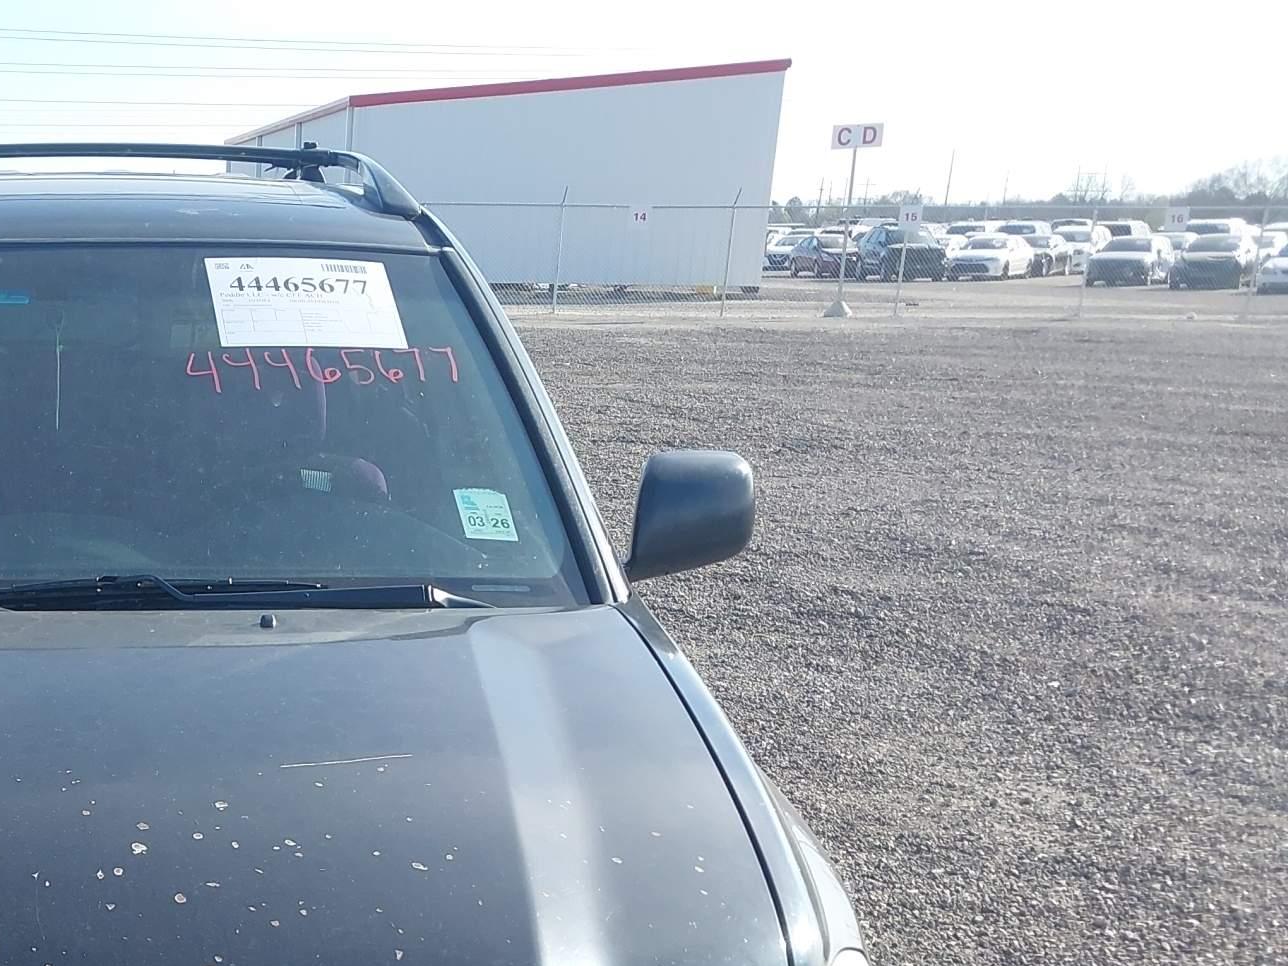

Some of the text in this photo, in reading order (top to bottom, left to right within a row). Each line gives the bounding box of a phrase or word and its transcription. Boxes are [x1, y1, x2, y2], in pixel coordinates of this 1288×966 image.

[837, 126, 877, 146] C D
[633, 212, 647, 222] 14
[905, 212, 918, 222] 15
[1171, 214, 1184, 224] 16
[229, 275, 367, 295] 44465677
[186, 348, 458, 393] 44465677
[468, 515, 510, 529] 03 26
